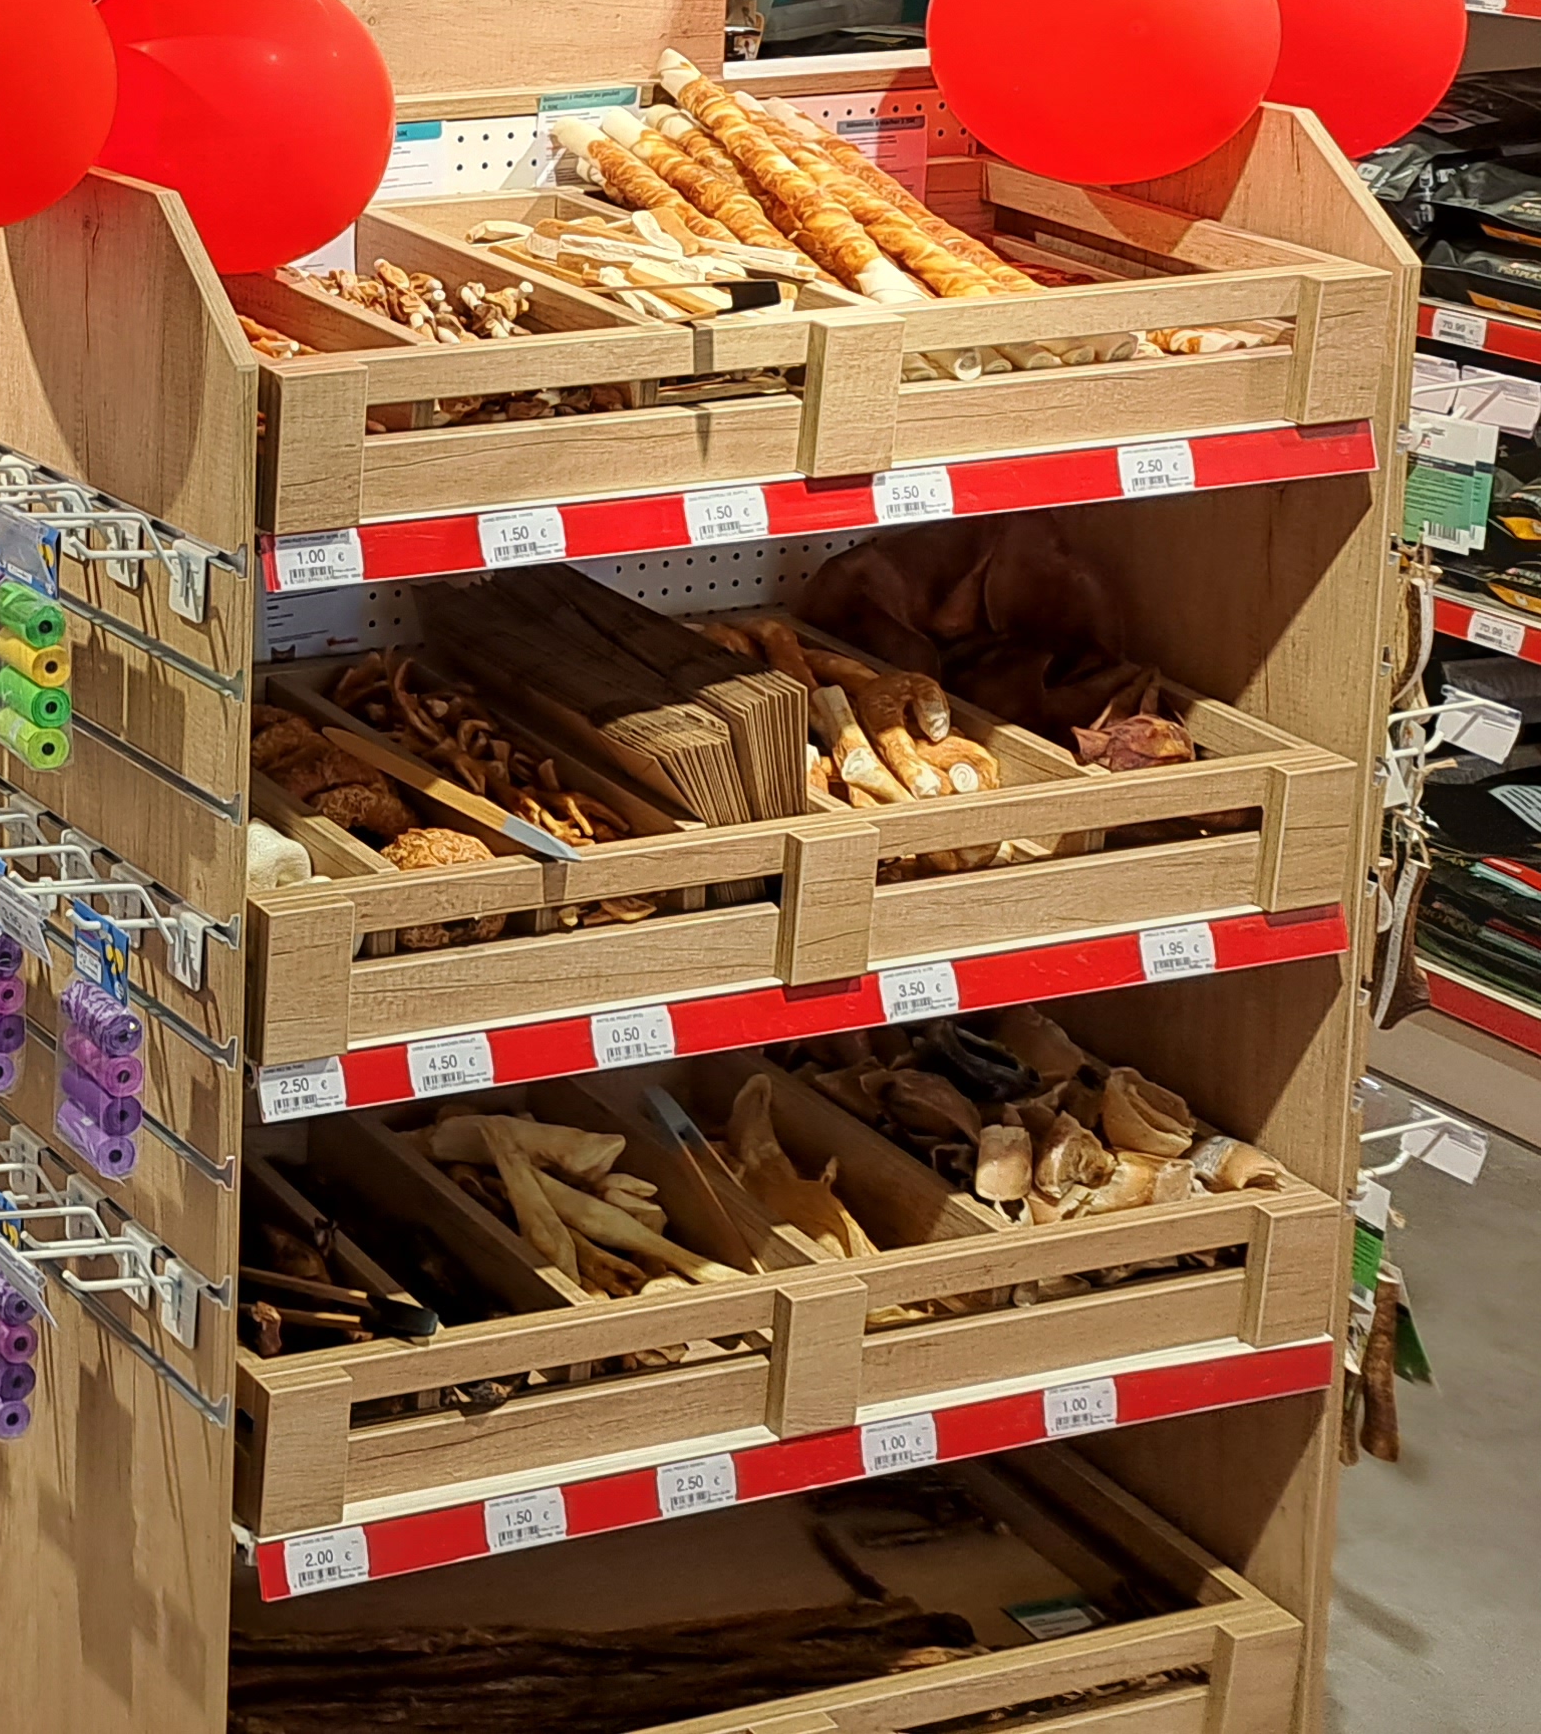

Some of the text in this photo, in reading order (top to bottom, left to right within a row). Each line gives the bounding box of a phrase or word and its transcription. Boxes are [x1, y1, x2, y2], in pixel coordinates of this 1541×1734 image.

[1136, 458, 1164, 474] 2.50
[891, 484, 920, 501] 5.50
[705, 504, 733, 521] 1.50
[499, 525, 530, 543] 1.50
[296, 548, 326, 565] 1.00
[1157, 939, 1187, 958] 1.95
[897, 979, 927, 1000] 3.50
[609, 1026, 641, 1046] 0.50
[426, 1052, 459, 1074] 4.50
[279, 1076, 312, 1097] 2.50
[1061, 1396, 1089, 1414] 1.00
[879, 1434, 907, 1452] 1.00
[675, 1473, 705, 1493] 2.50
[504, 1509, 533, 1528] 1.50
[304, 1549, 334, 1569] 2.00
